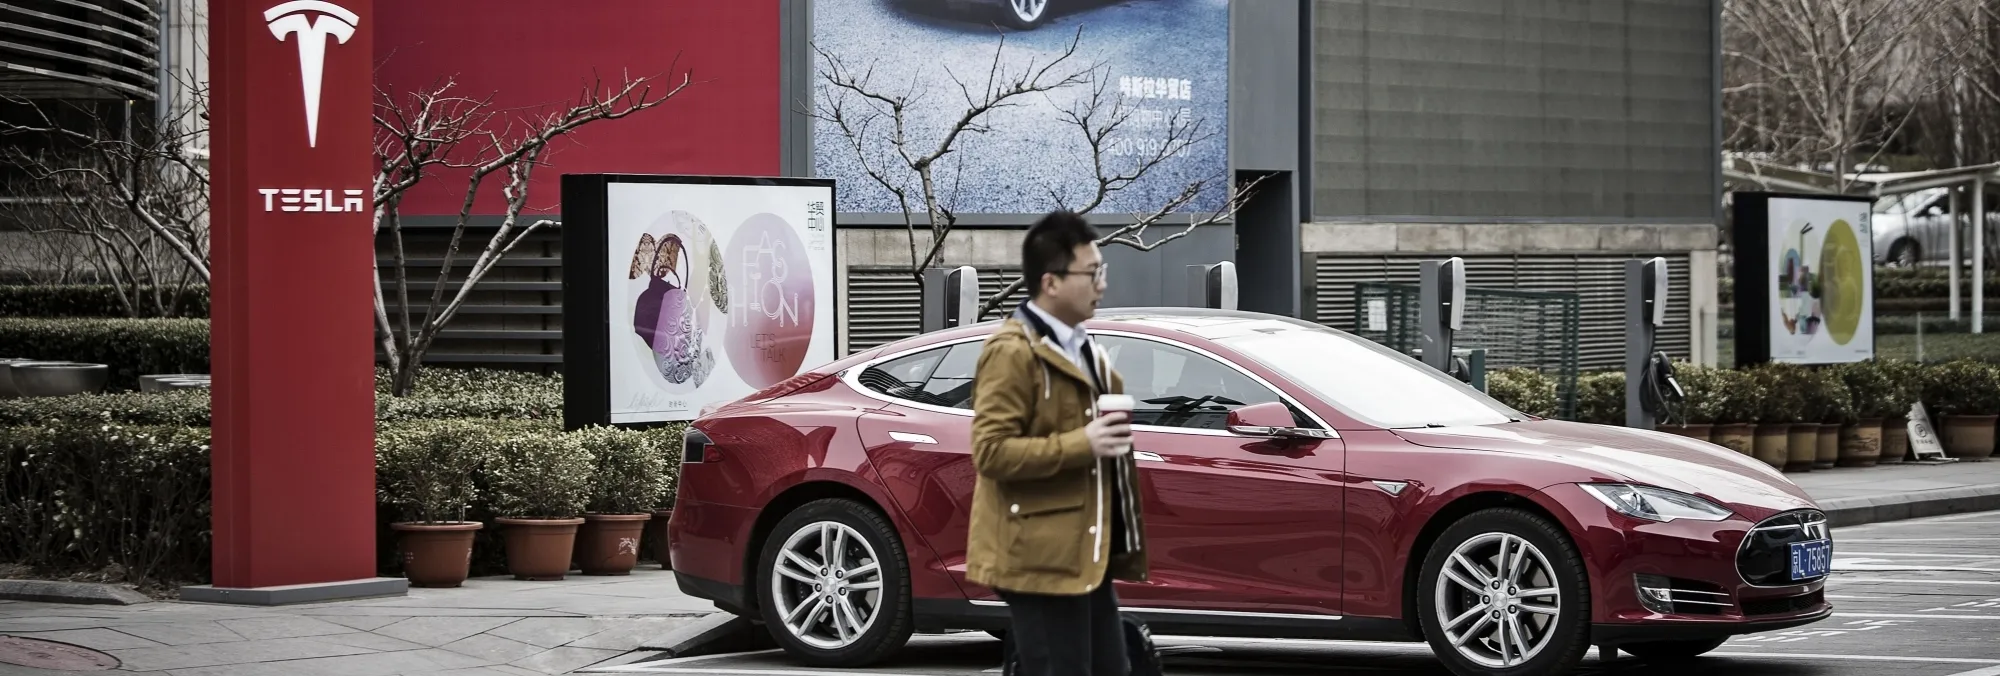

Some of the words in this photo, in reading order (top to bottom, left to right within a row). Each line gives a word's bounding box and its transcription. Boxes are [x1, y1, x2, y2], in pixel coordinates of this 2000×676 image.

[1119, 76, 1192, 100] 特斯拉华贸店
[258, 188, 364, 212] TESLA
